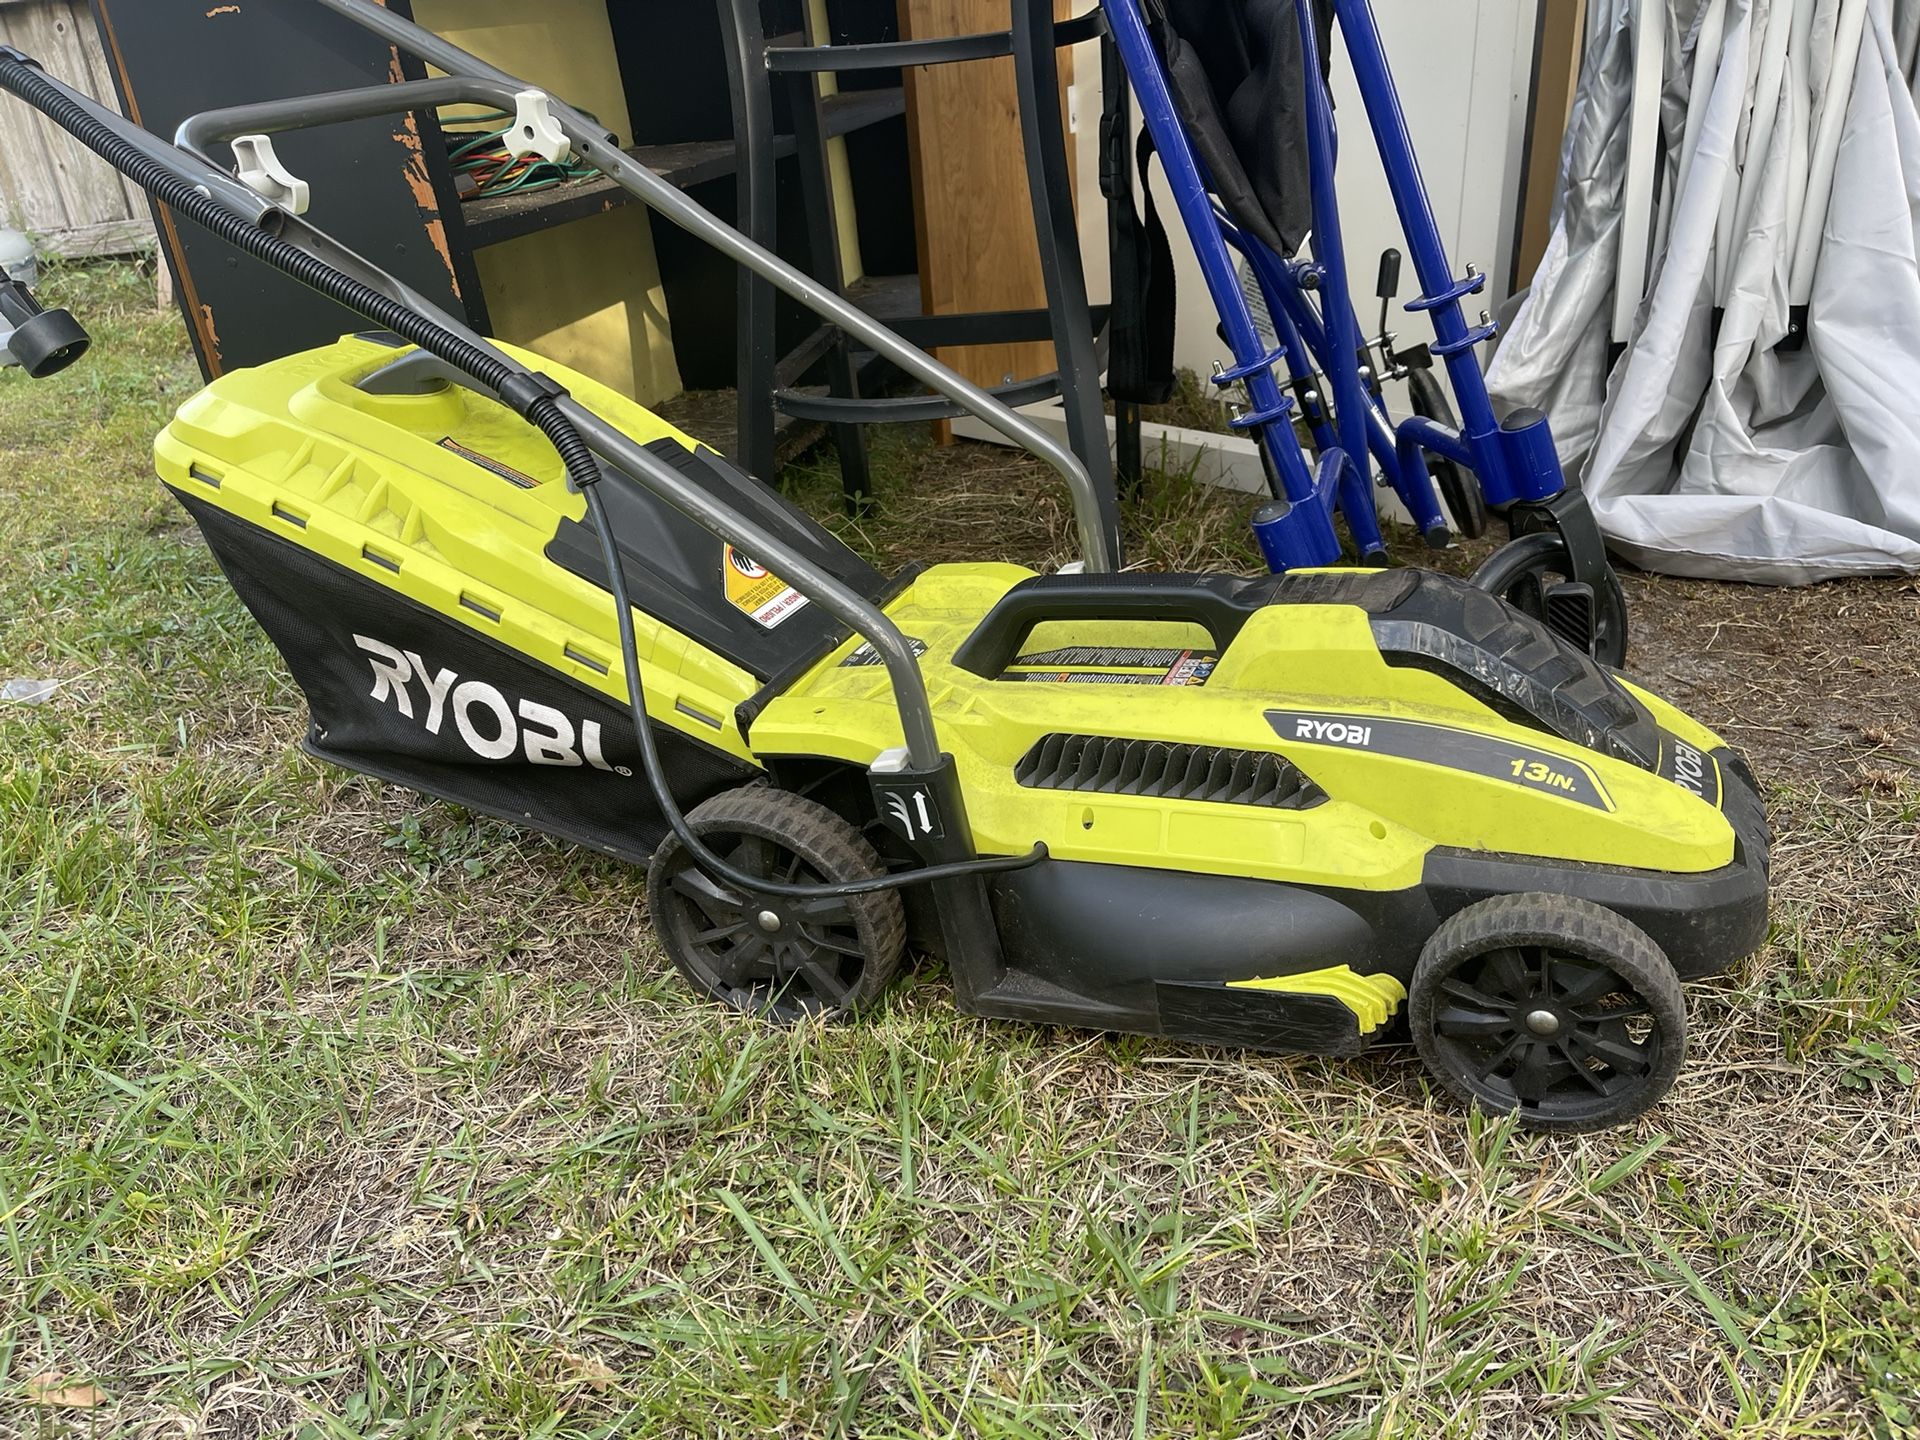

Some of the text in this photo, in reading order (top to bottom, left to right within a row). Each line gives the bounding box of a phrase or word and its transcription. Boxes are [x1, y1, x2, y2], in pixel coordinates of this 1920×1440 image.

[782, 591, 803, 606] ANGER
[759, 604, 784, 623] PELIGRO
[352, 633, 614, 772] RYOBI
[1296, 718, 1372, 746] RYOBI
